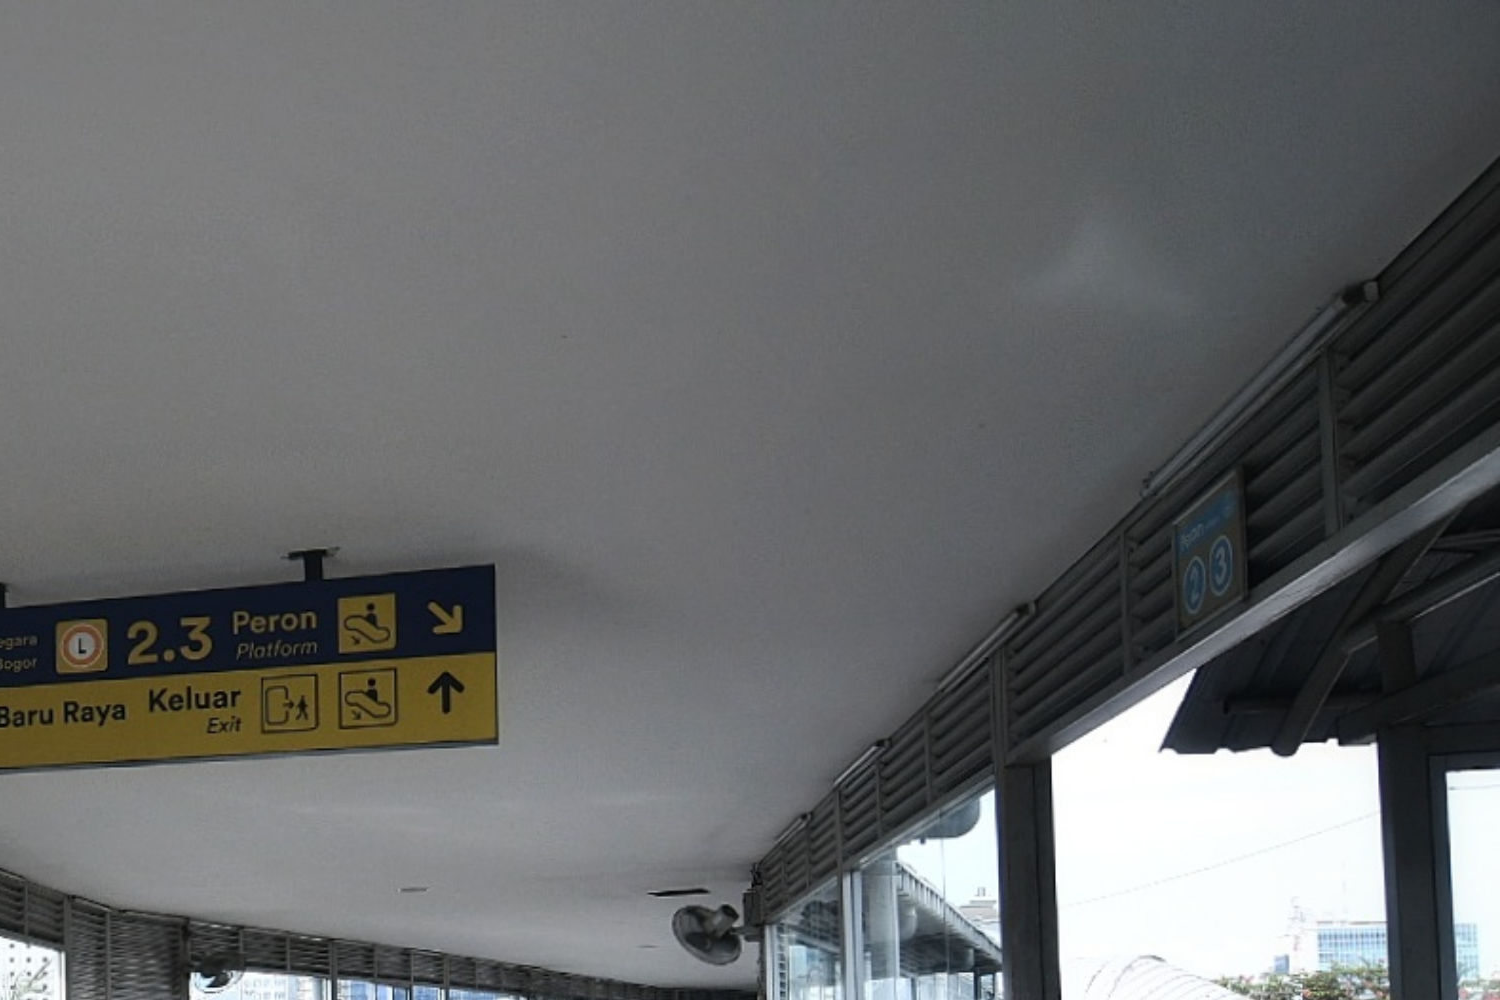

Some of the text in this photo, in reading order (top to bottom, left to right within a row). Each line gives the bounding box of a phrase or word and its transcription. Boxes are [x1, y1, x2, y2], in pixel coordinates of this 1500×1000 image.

[232, 610, 317, 635] Peron
[127, 616, 213, 665] 2.3
[236, 640, 318, 660] Platform
[149, 686, 241, 713] Keluar
[63, 701, 126, 727] Raya
[207, 716, 241, 734] Exit
